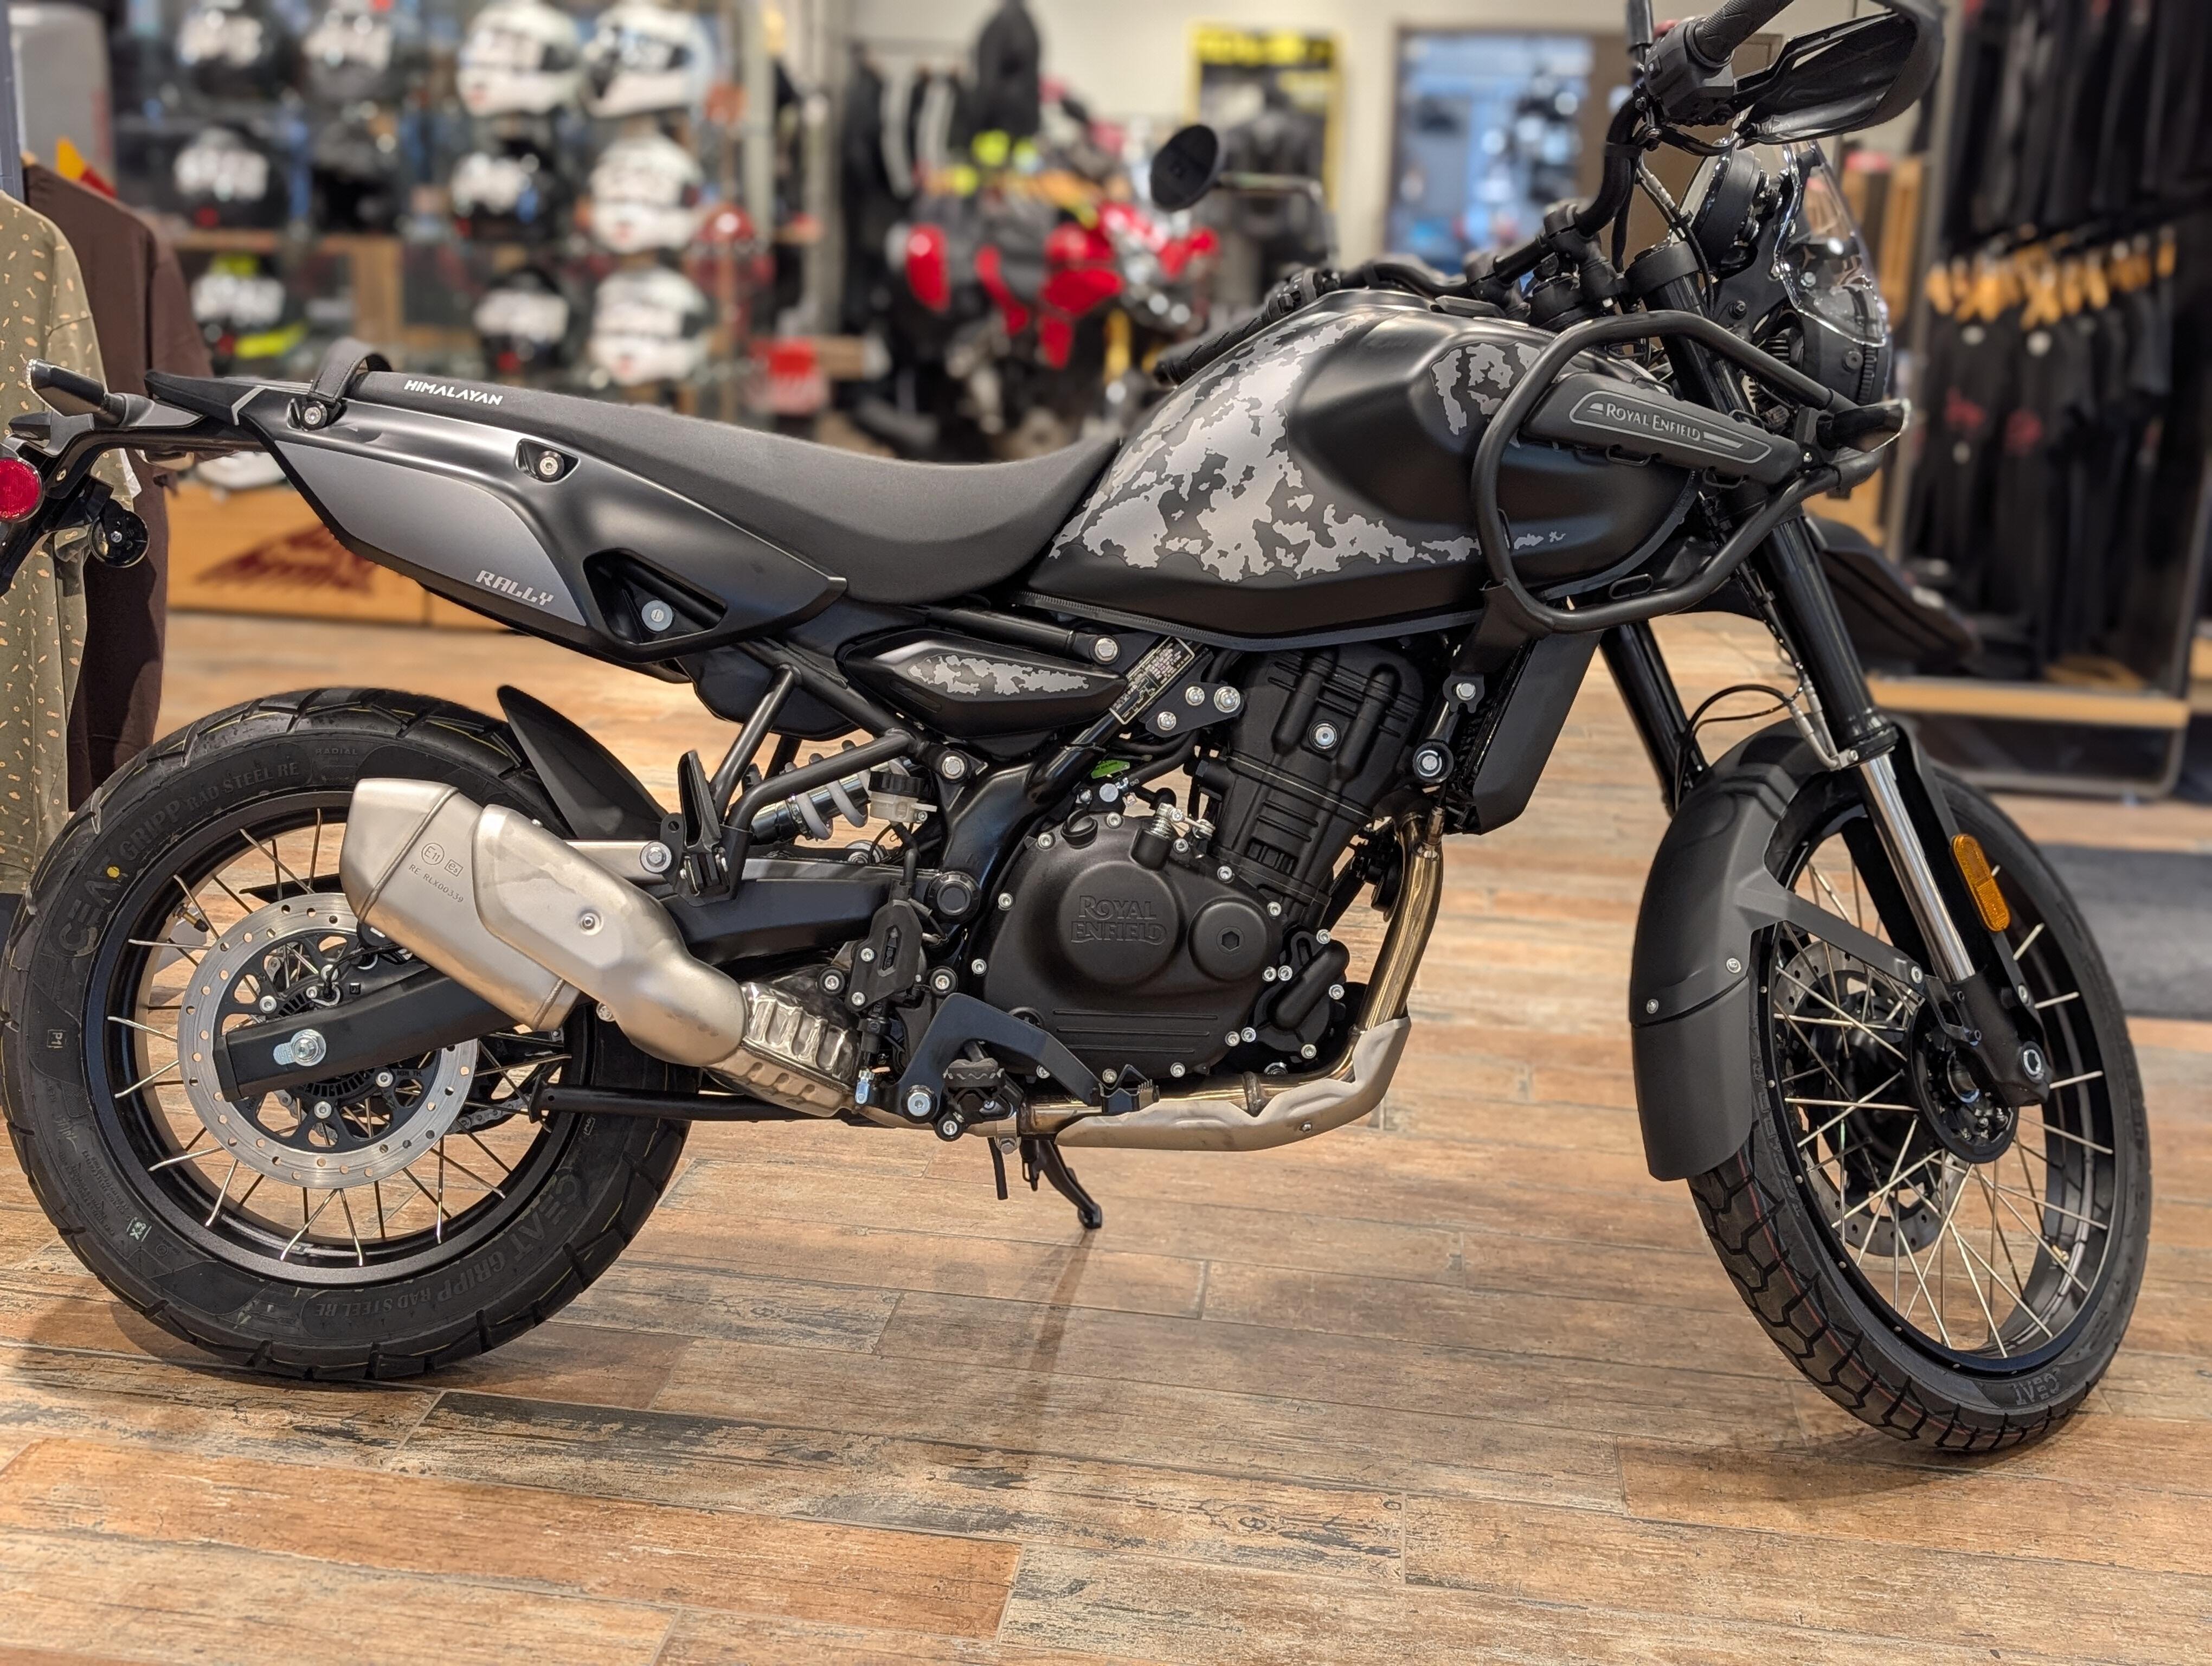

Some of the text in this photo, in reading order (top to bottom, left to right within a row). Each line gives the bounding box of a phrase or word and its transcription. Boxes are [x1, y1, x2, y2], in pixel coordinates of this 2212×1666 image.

[404, 380, 503, 406] HIMALAYAN
[1606, 403, 1701, 441] ROYAL ENFIELD
[475, 570, 554, 606] RALLY
[409, 864, 421, 875] RE
[1078, 895, 1157, 921] ROYAL
[1071, 921, 1168, 945] ENFIELD
